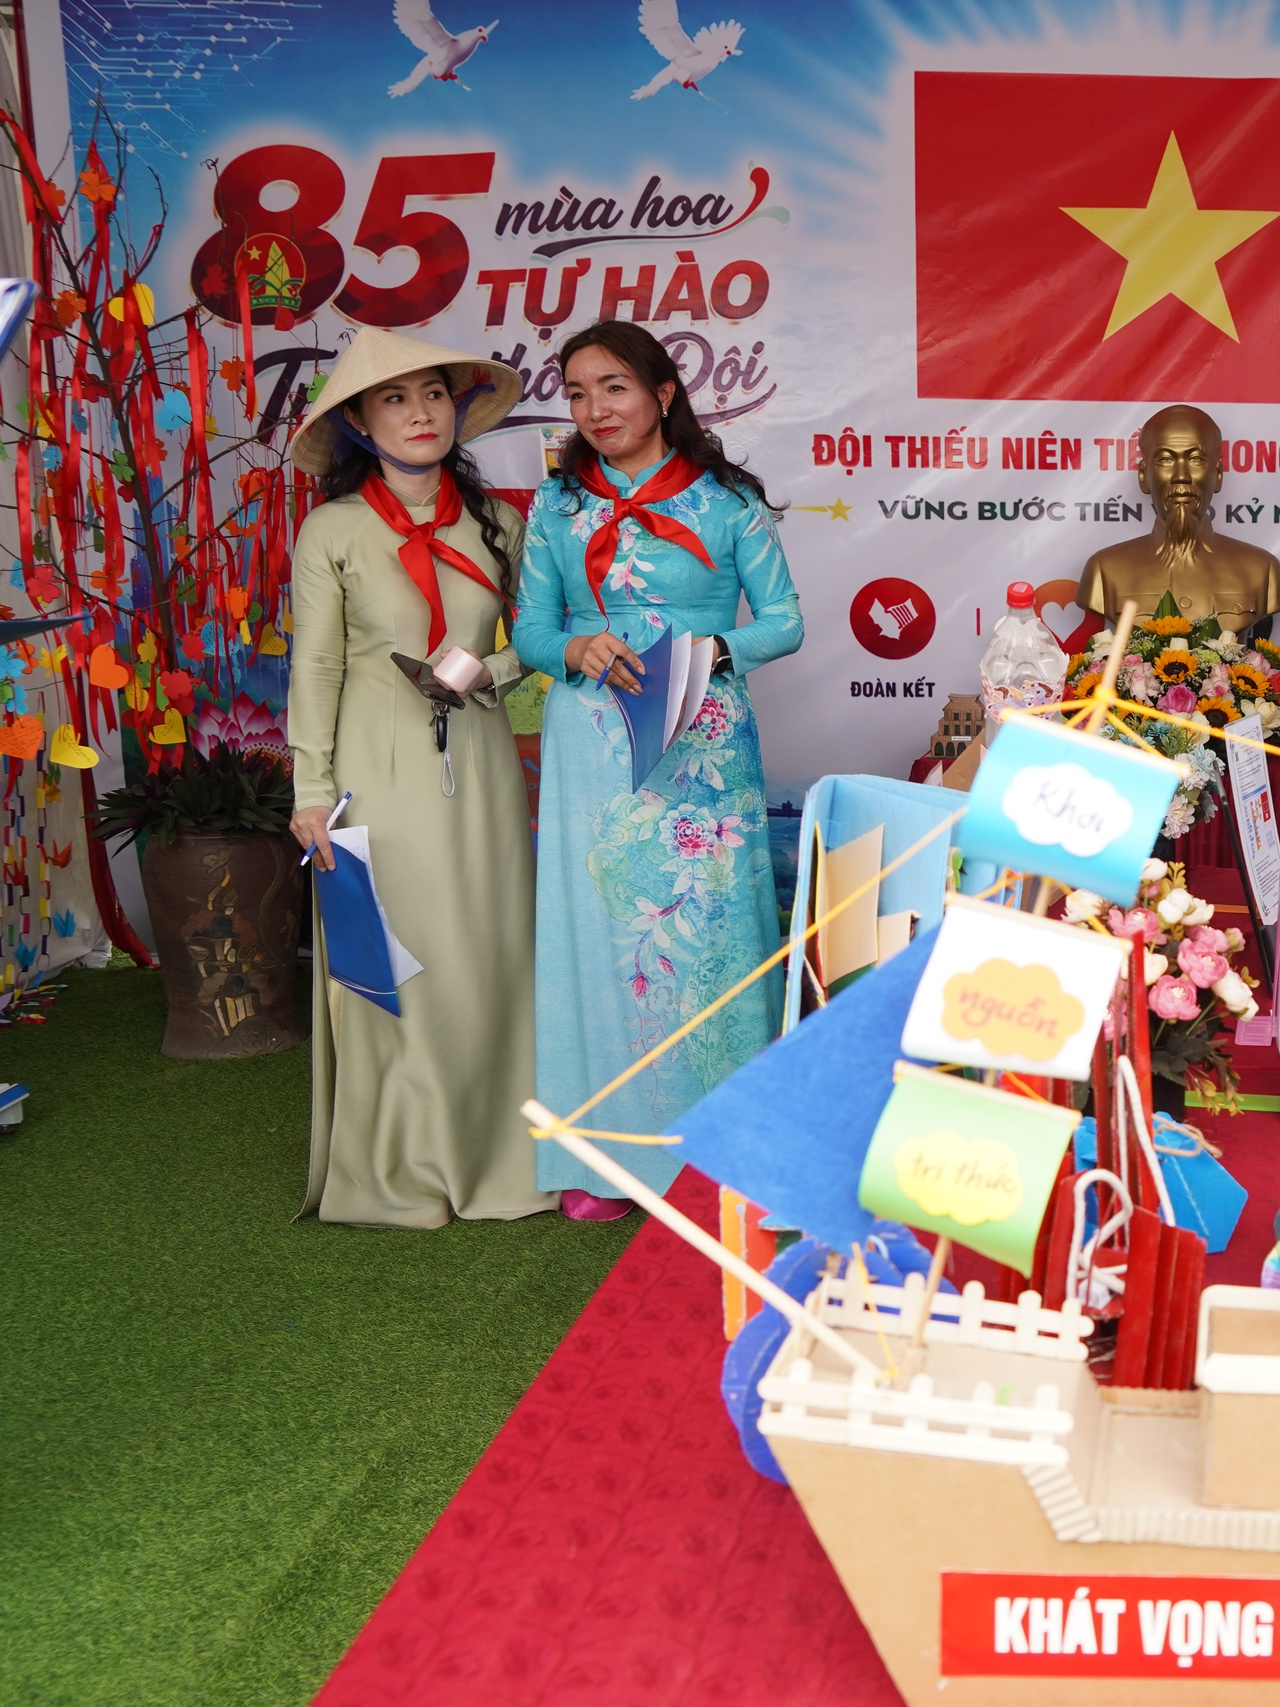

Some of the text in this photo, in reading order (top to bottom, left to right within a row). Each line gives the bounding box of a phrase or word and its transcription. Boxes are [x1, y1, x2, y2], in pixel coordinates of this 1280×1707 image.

[190, 144, 496, 328] 85
[495, 175, 734, 237] mùa hoa
[476, 250, 770, 341] TỰ HÀO
[811, 427, 873, 476] ĐỘI
[885, 426, 988, 470] THIẾU
[1001, 430, 1082, 471] NIÊN
[1093, 428, 1143, 471] TIỀ
[877, 494, 968, 522] VỮNG
[977, 495, 1066, 522] BƯỚC
[1073, 495, 1142, 523] TIẾN
[1225, 497, 1261, 524] KỶ
[850, 676, 936, 698] ĐOÀN KẾT
[993, 1586, 1127, 1656] KHÁT
[1137, 1598, 1275, 1669] VỌNG
